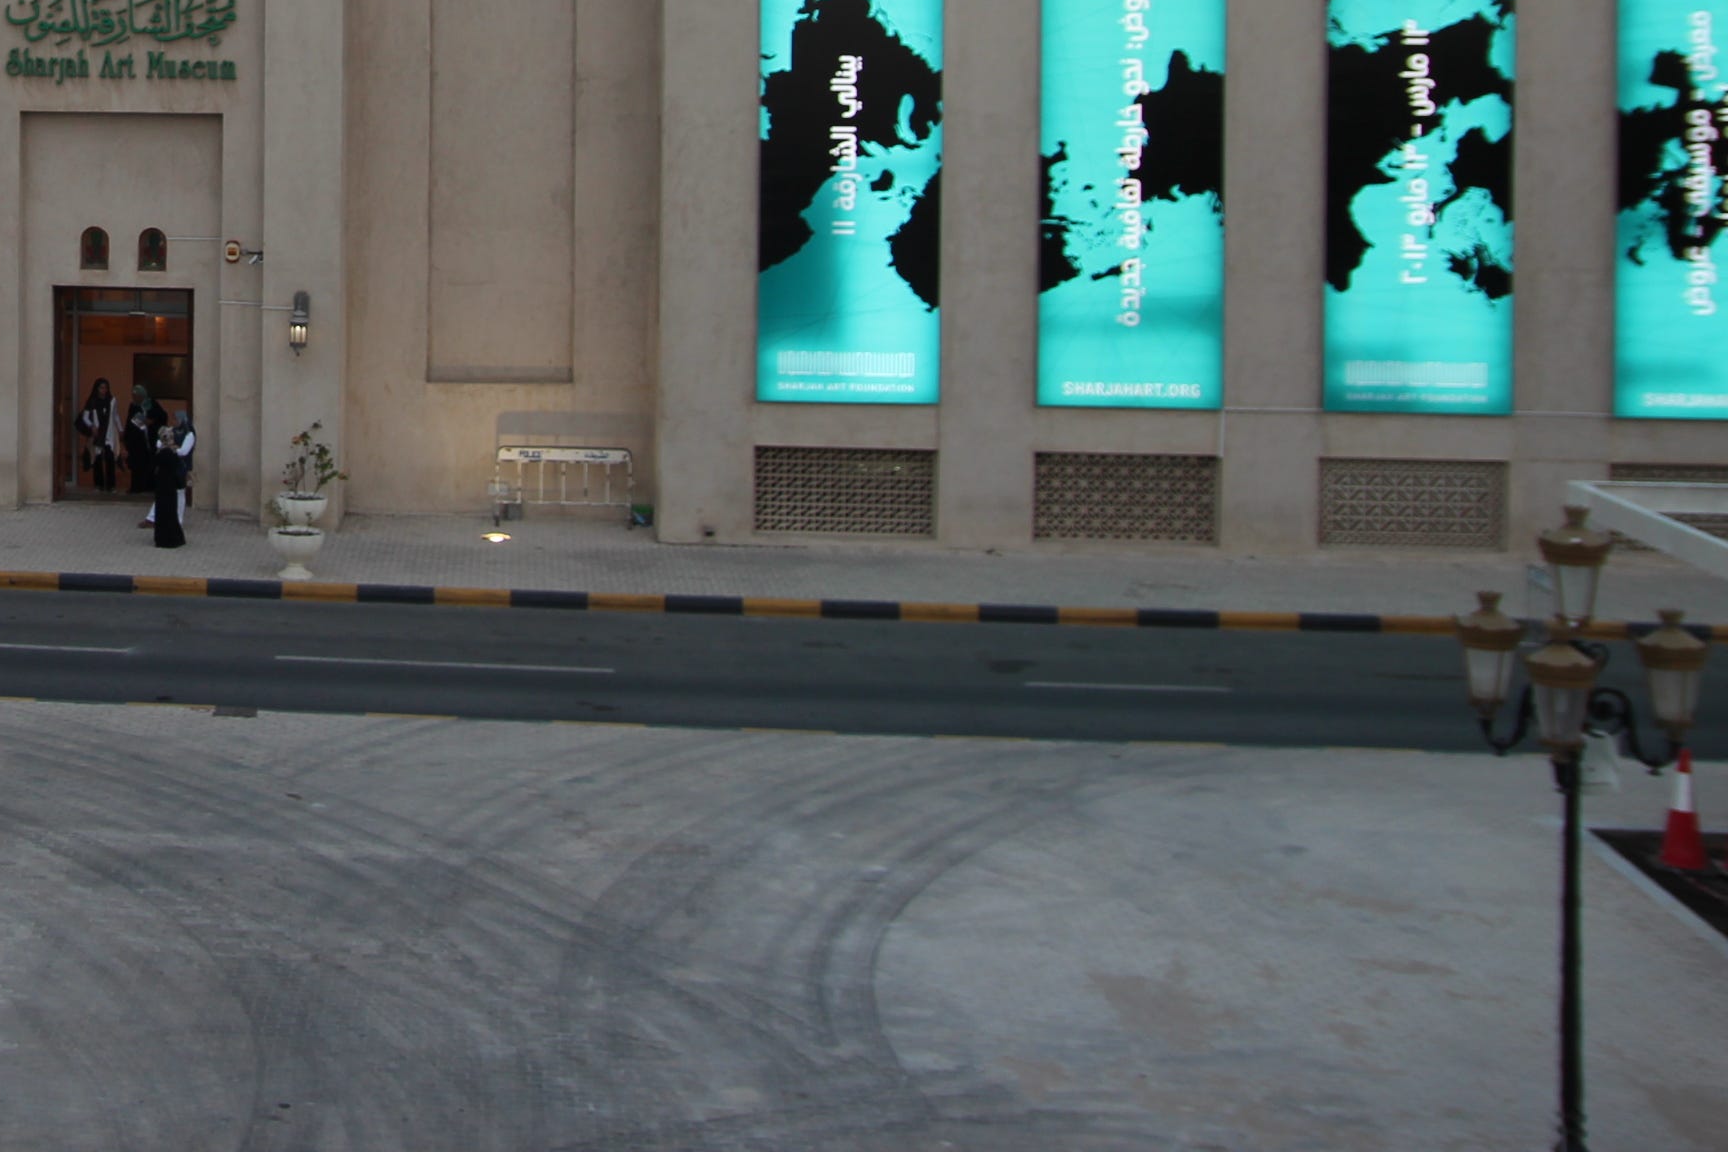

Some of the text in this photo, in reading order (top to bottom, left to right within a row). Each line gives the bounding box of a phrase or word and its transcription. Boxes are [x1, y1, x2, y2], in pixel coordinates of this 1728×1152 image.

[5, 47, 238, 85] Sharjah Art Museum
[829, 55, 863, 118] بينالي
[1119, 58, 1150, 97] نحو
[1398, 53, 1436, 116] مارس
[1115, 102, 1149, 171] خارطة
[829, 126, 863, 211] الشارقة
[1400, 178, 1436, 226] مايو
[1116, 257, 1145, 328] جديدة
[1063, 381, 1201, 398] SHARJAHART.ORG
